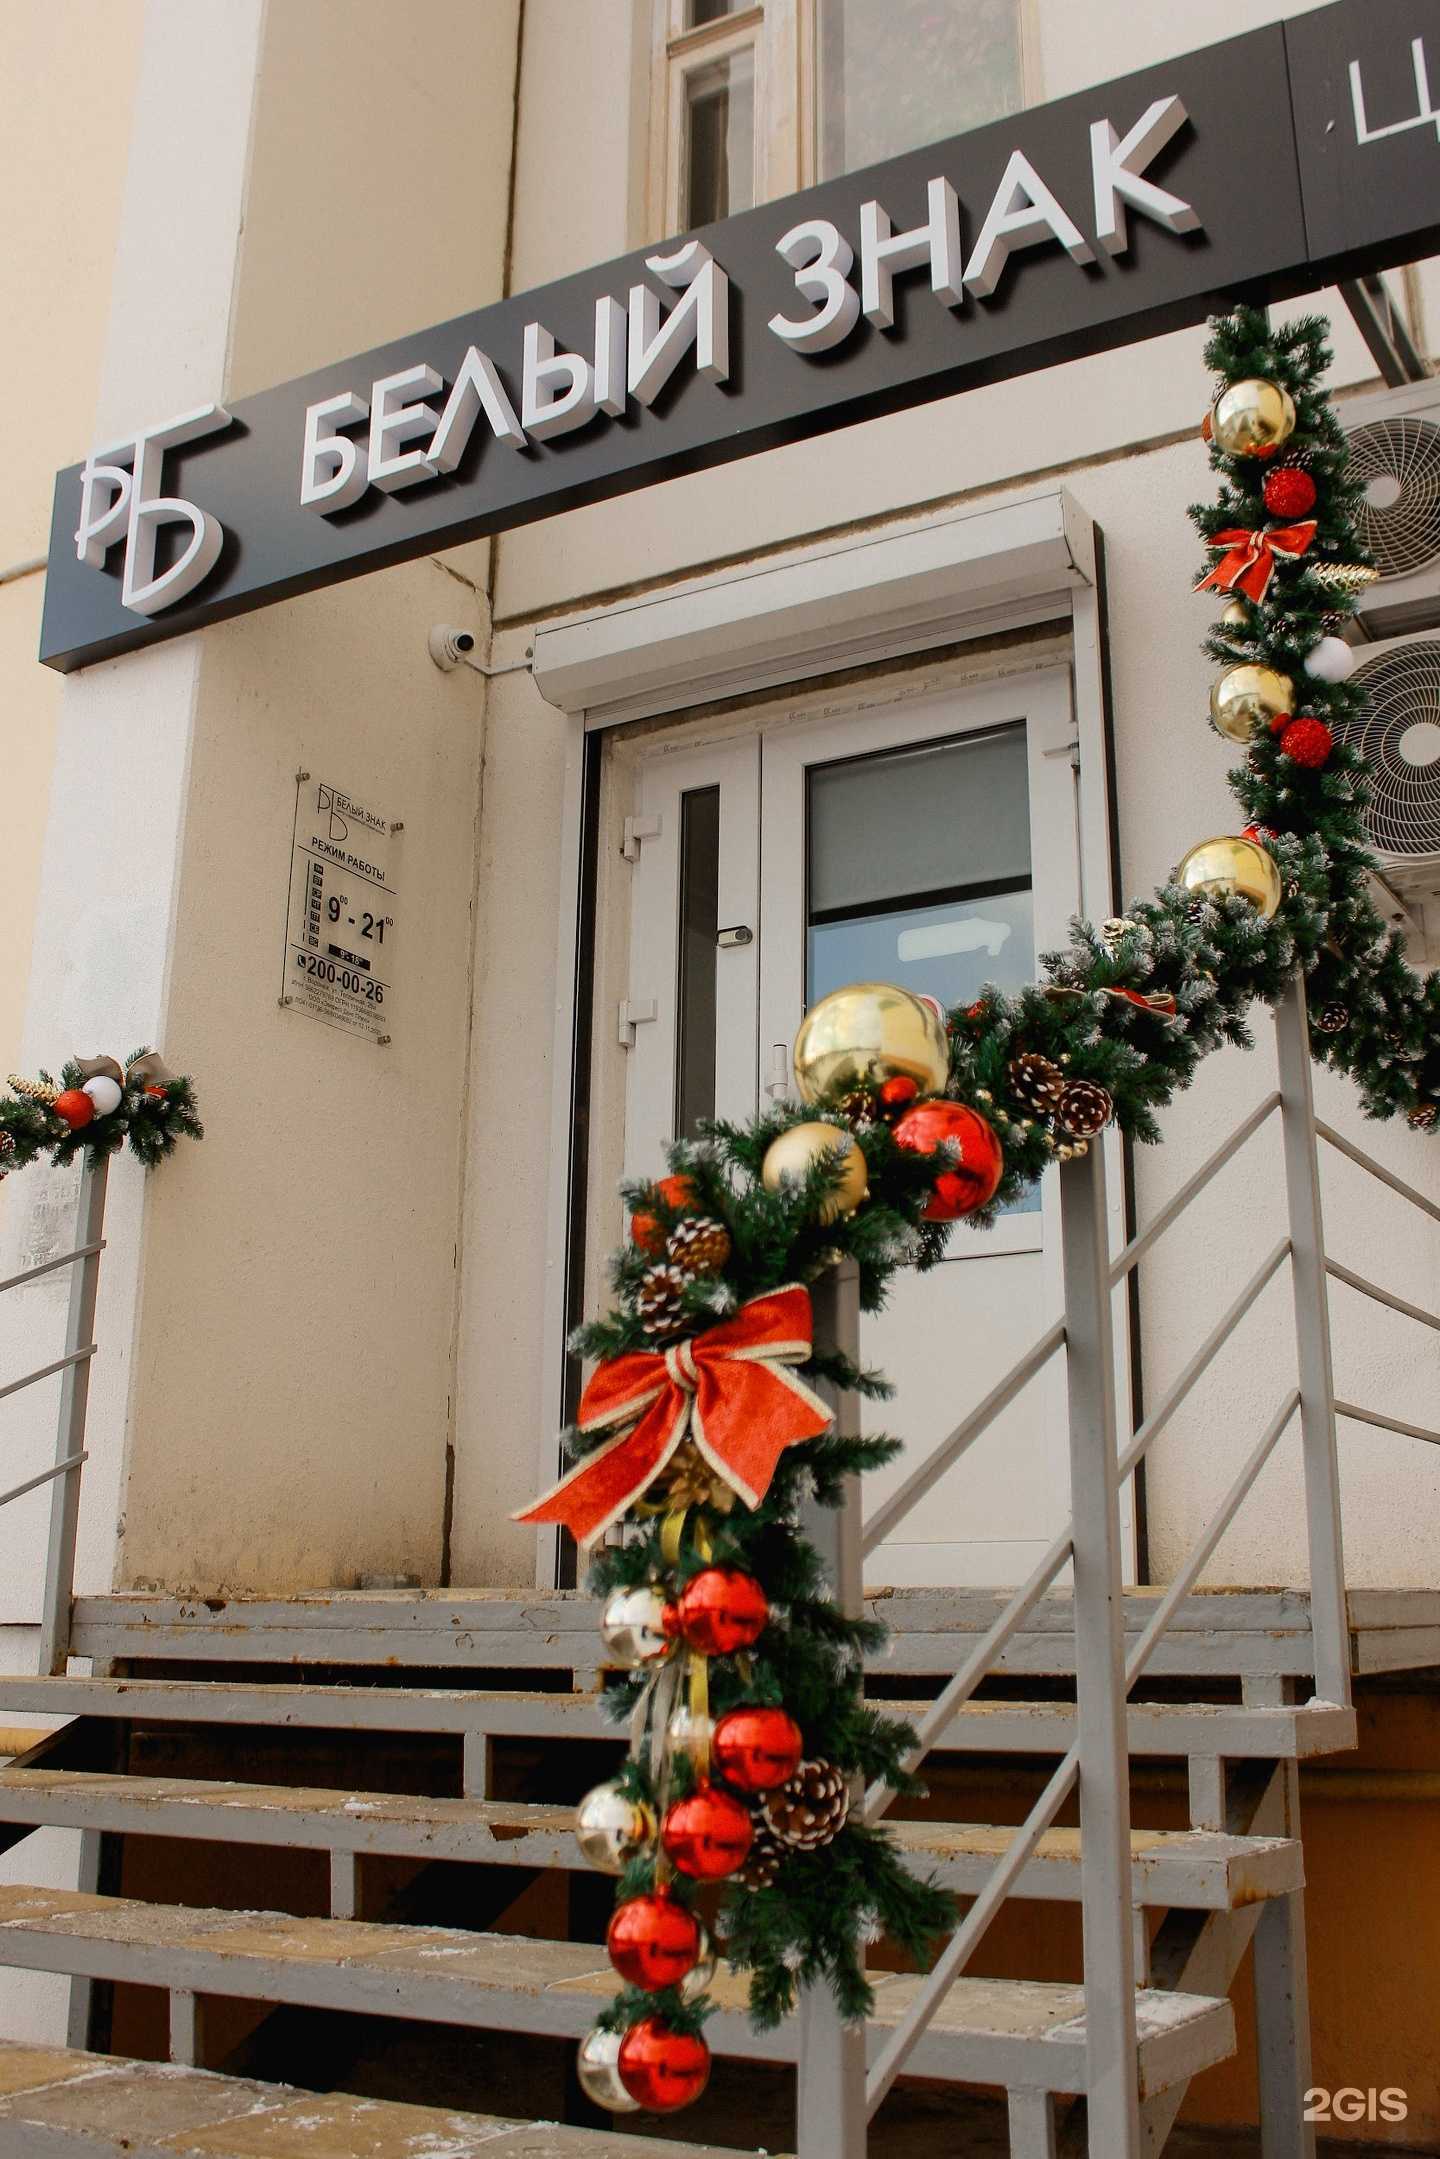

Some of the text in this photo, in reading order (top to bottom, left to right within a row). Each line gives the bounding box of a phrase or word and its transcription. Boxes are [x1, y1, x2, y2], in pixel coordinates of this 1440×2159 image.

[300, 94, 1202, 516] БЕЛЫЙ ЗНАК
[336, 796, 364, 819] БЕЛЫЙ
[365, 812, 387, 831] ЗНАК
[311, 836, 346, 862] РЕЖИМ
[347, 854, 385, 882] РАБОТЫ
[307, 956, 384, 1004] 200-00-26
